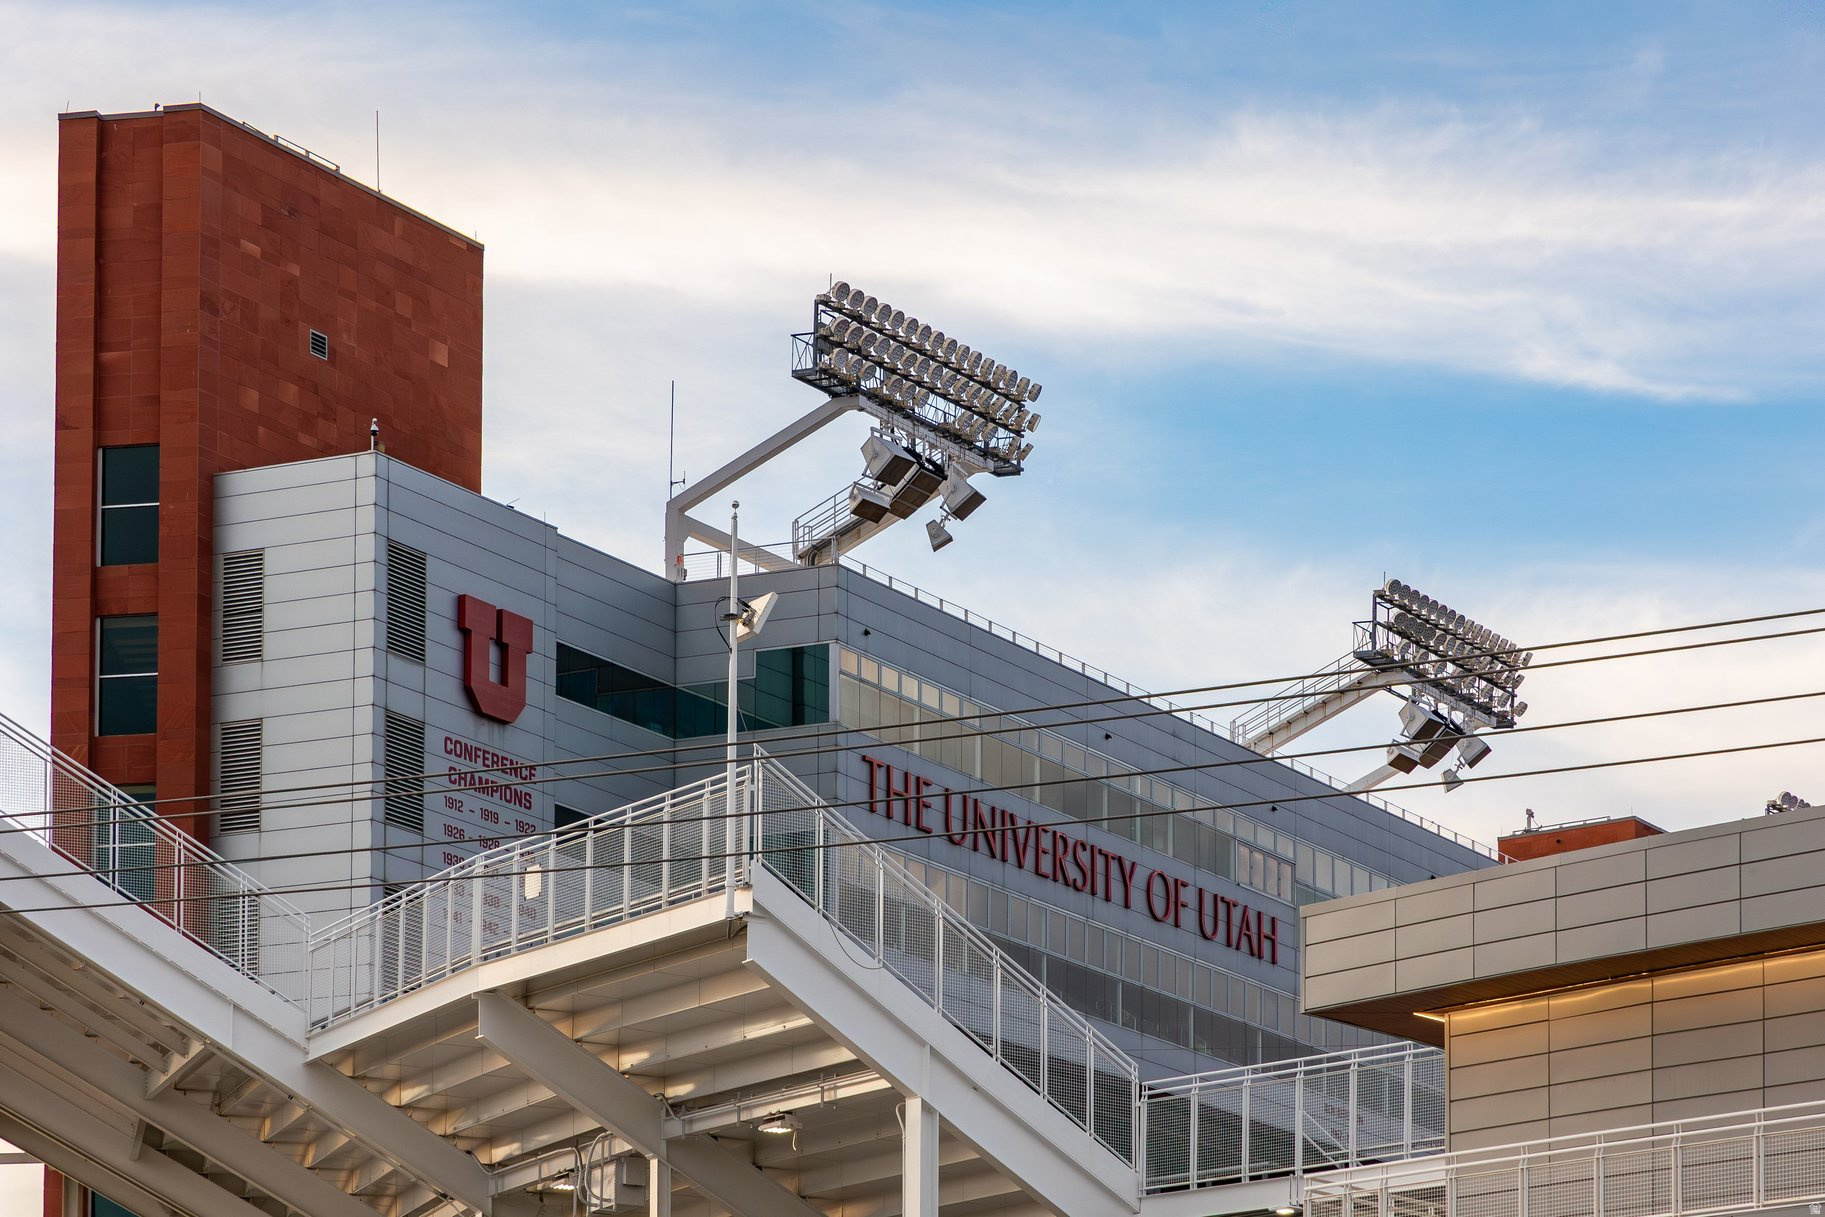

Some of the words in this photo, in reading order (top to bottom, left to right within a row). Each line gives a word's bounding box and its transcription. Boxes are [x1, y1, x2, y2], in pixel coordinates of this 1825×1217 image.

[457, 594, 534, 725] U
[443, 736, 537, 784] CONFERENCE
[448, 766, 533, 811] CHAMPIONS
[443, 795, 464, 813] 1912
[480, 807, 500, 825] 1919
[515, 819, 537, 834] 1922
[443, 823, 466, 840] 1926
[478, 835, 501, 851] 1928
[862, 755, 933, 834] THE
[944, 788, 1138, 909] UNIVERSITY
[1146, 869, 1189, 928] OF
[1199, 887, 1278, 965] UTAH
